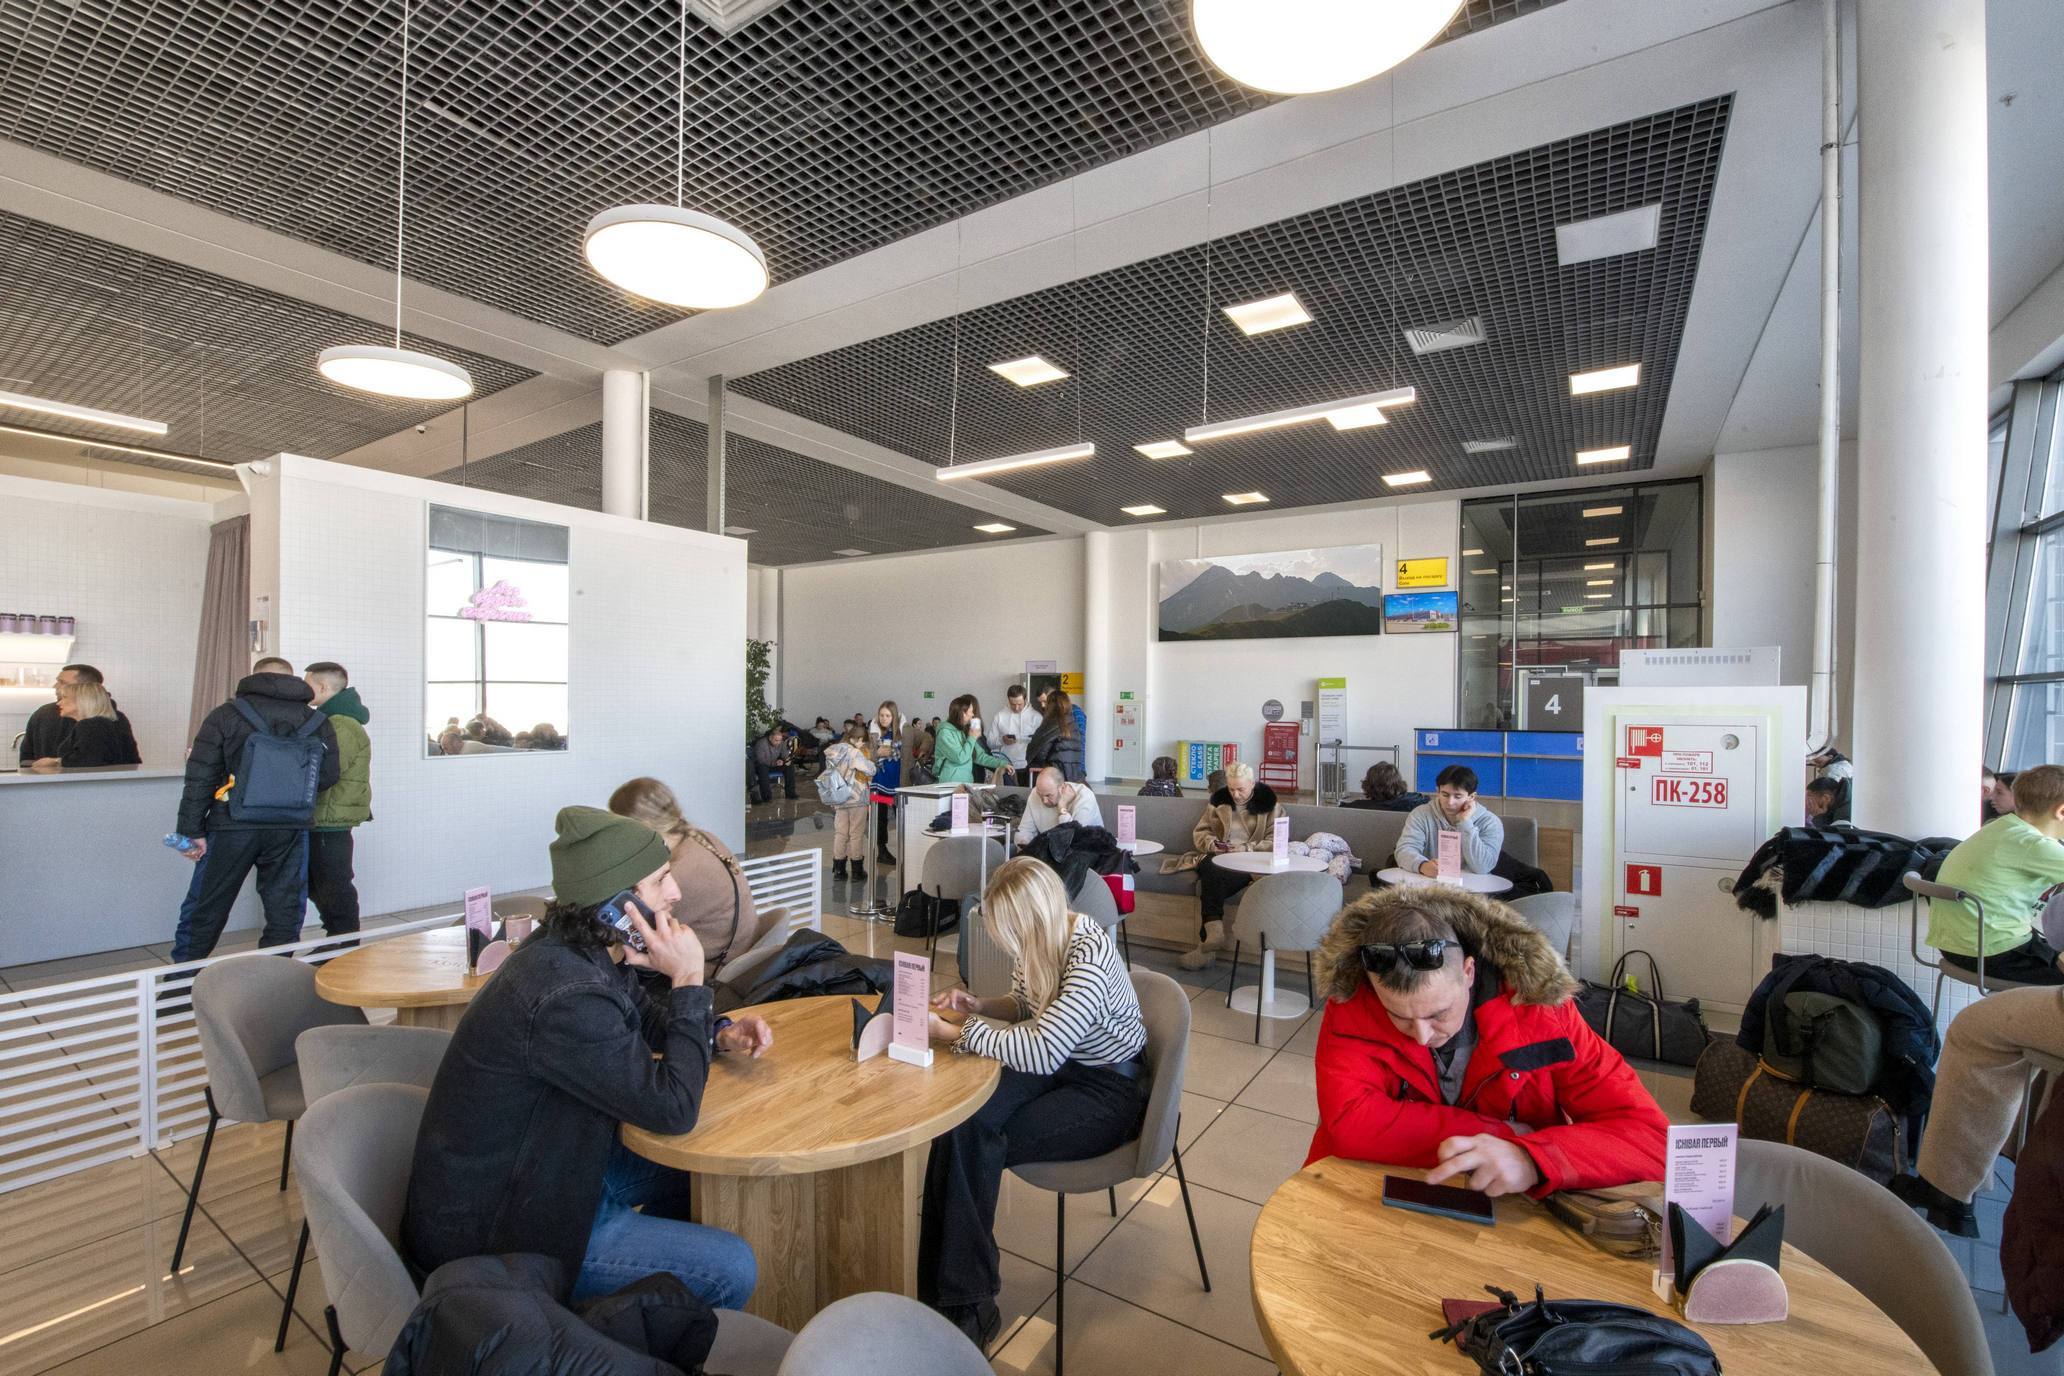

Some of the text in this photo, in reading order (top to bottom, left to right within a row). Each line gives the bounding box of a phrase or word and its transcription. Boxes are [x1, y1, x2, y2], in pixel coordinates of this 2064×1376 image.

[1399, 563, 1408, 574] 4
[1062, 674, 1069, 685] 2
[1544, 694, 1562, 715] 4
[1656, 779, 1725, 804] ПК-258
[1702, 1135, 1729, 1149] ПЕРВЫЙ
